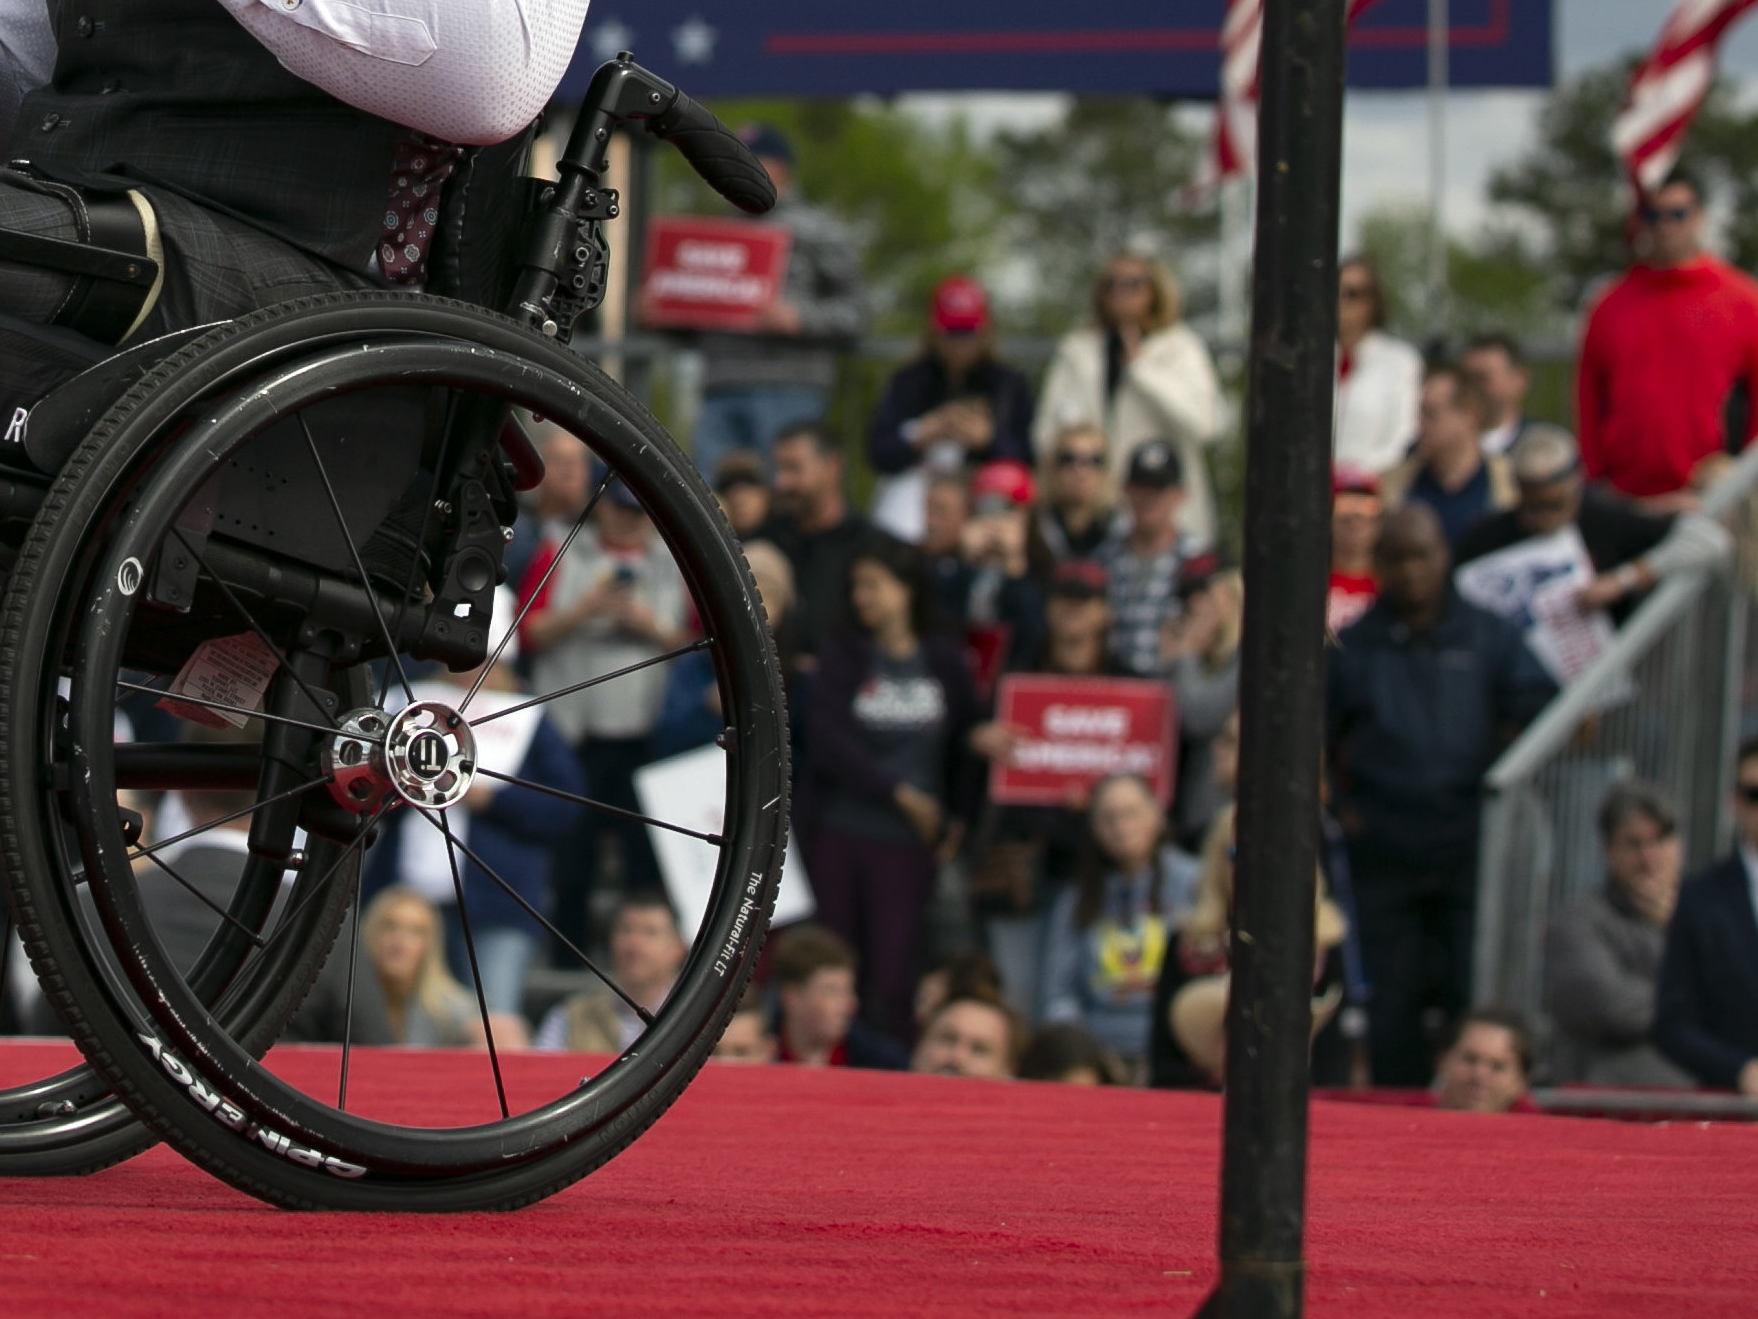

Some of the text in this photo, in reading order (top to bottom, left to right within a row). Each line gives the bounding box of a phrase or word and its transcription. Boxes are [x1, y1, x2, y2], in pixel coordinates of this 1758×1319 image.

[420, 739, 441, 771] Ti
[713, 871, 763, 977] The Natural-Fit LT
